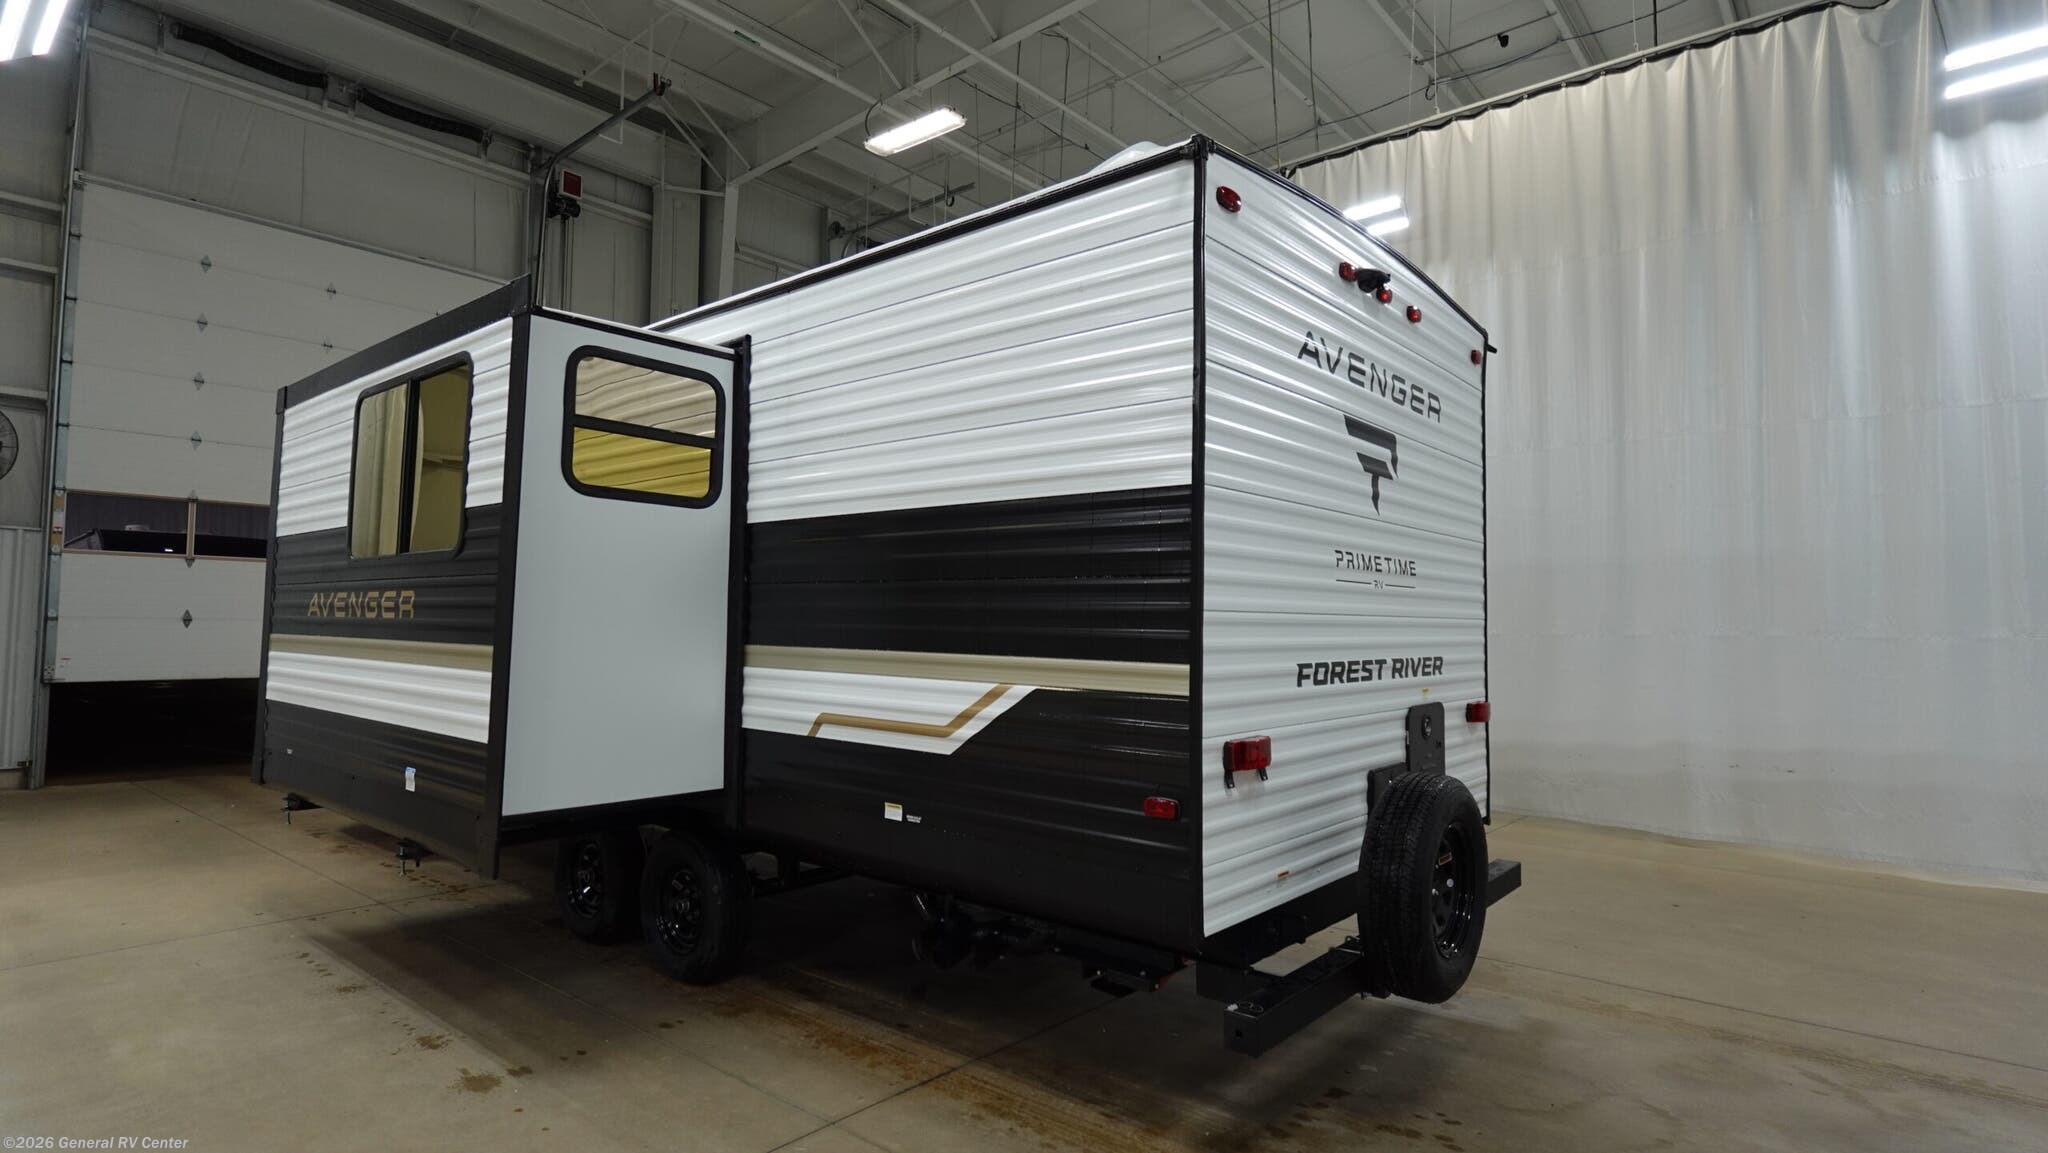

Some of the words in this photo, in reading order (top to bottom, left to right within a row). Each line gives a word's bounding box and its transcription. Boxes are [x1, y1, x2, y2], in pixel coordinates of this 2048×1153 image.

[1297, 330, 1442, 423] AVENGER
[1373, 579, 1384, 590] RV
[307, 589, 416, 620] AVENGER
[1296, 658, 1388, 688] FOREST
[1391, 656, 1444, 679] RIVER
